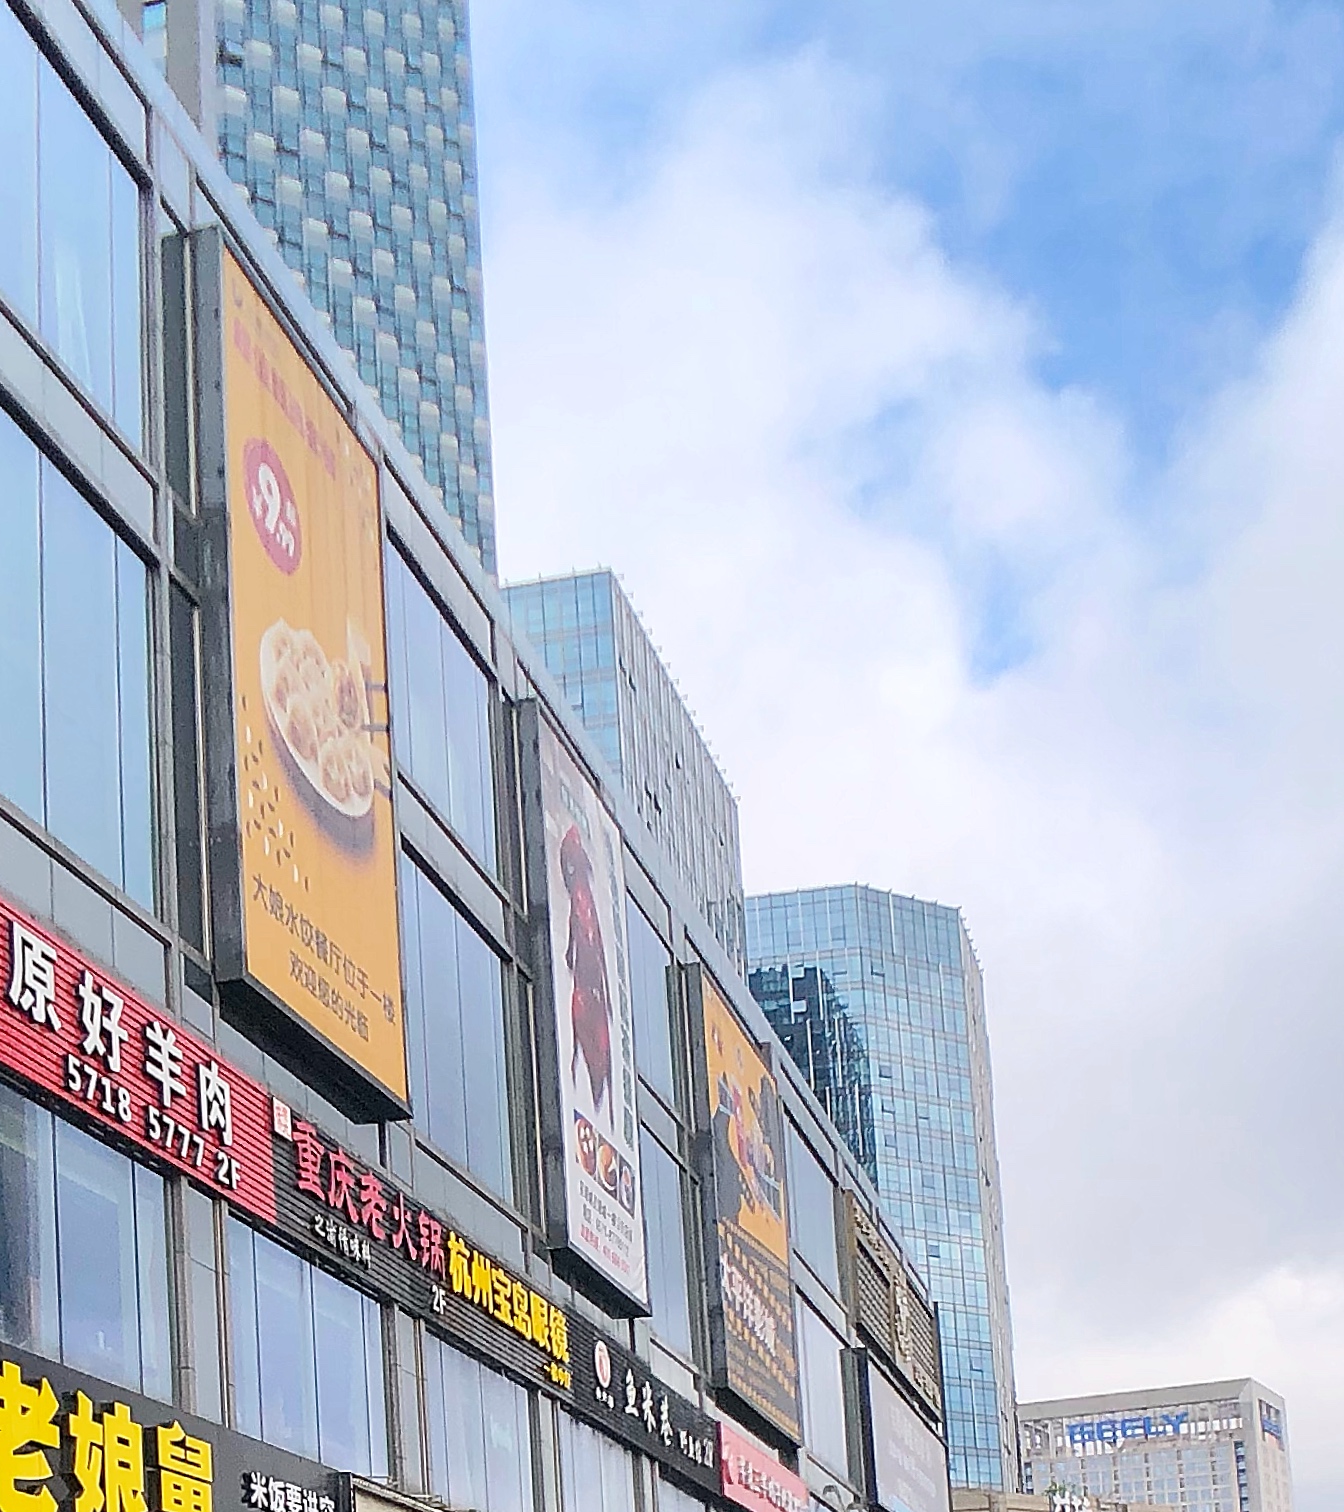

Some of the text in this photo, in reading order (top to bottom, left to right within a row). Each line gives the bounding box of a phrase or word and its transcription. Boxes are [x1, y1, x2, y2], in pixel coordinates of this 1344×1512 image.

[67, 1055, 132, 1122] 5718
[148, 1109, 205, 1167] 5777
[218, 1152, 241, 1190] 2F
[292, 1120, 446, 1280] 重庆老火锅
[447, 1231, 570, 1363] 杭州宝岛眼镜
